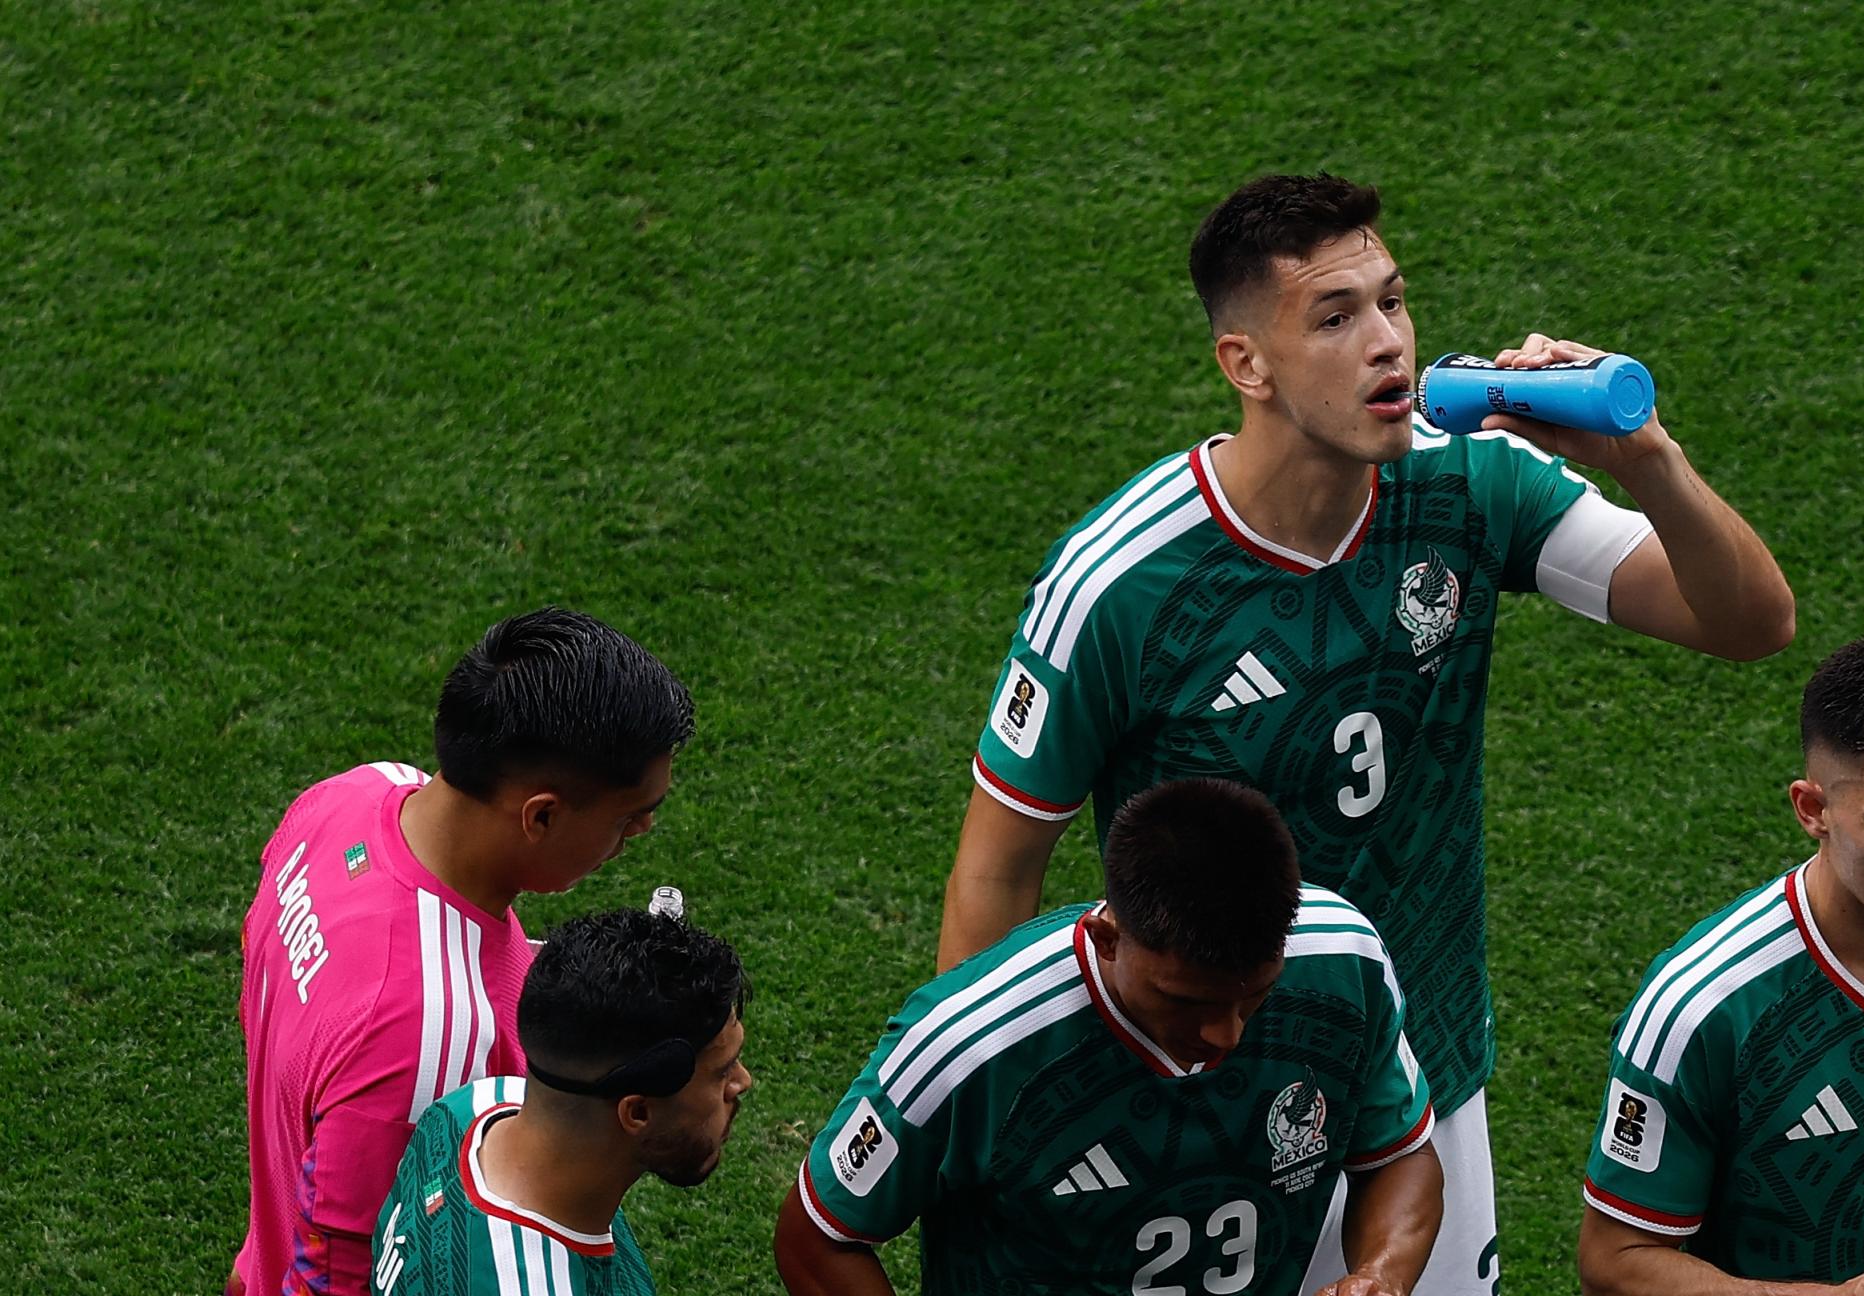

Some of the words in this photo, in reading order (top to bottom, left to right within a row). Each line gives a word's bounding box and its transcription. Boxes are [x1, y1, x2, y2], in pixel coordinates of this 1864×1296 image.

[1413, 622, 1455, 654] MÉXIC
[1333, 712, 1386, 818] 3
[837, 1155, 853, 1181] 2026
[1274, 1140, 1325, 1170] MÉXICO
[1610, 1144, 1639, 1162] 2026
